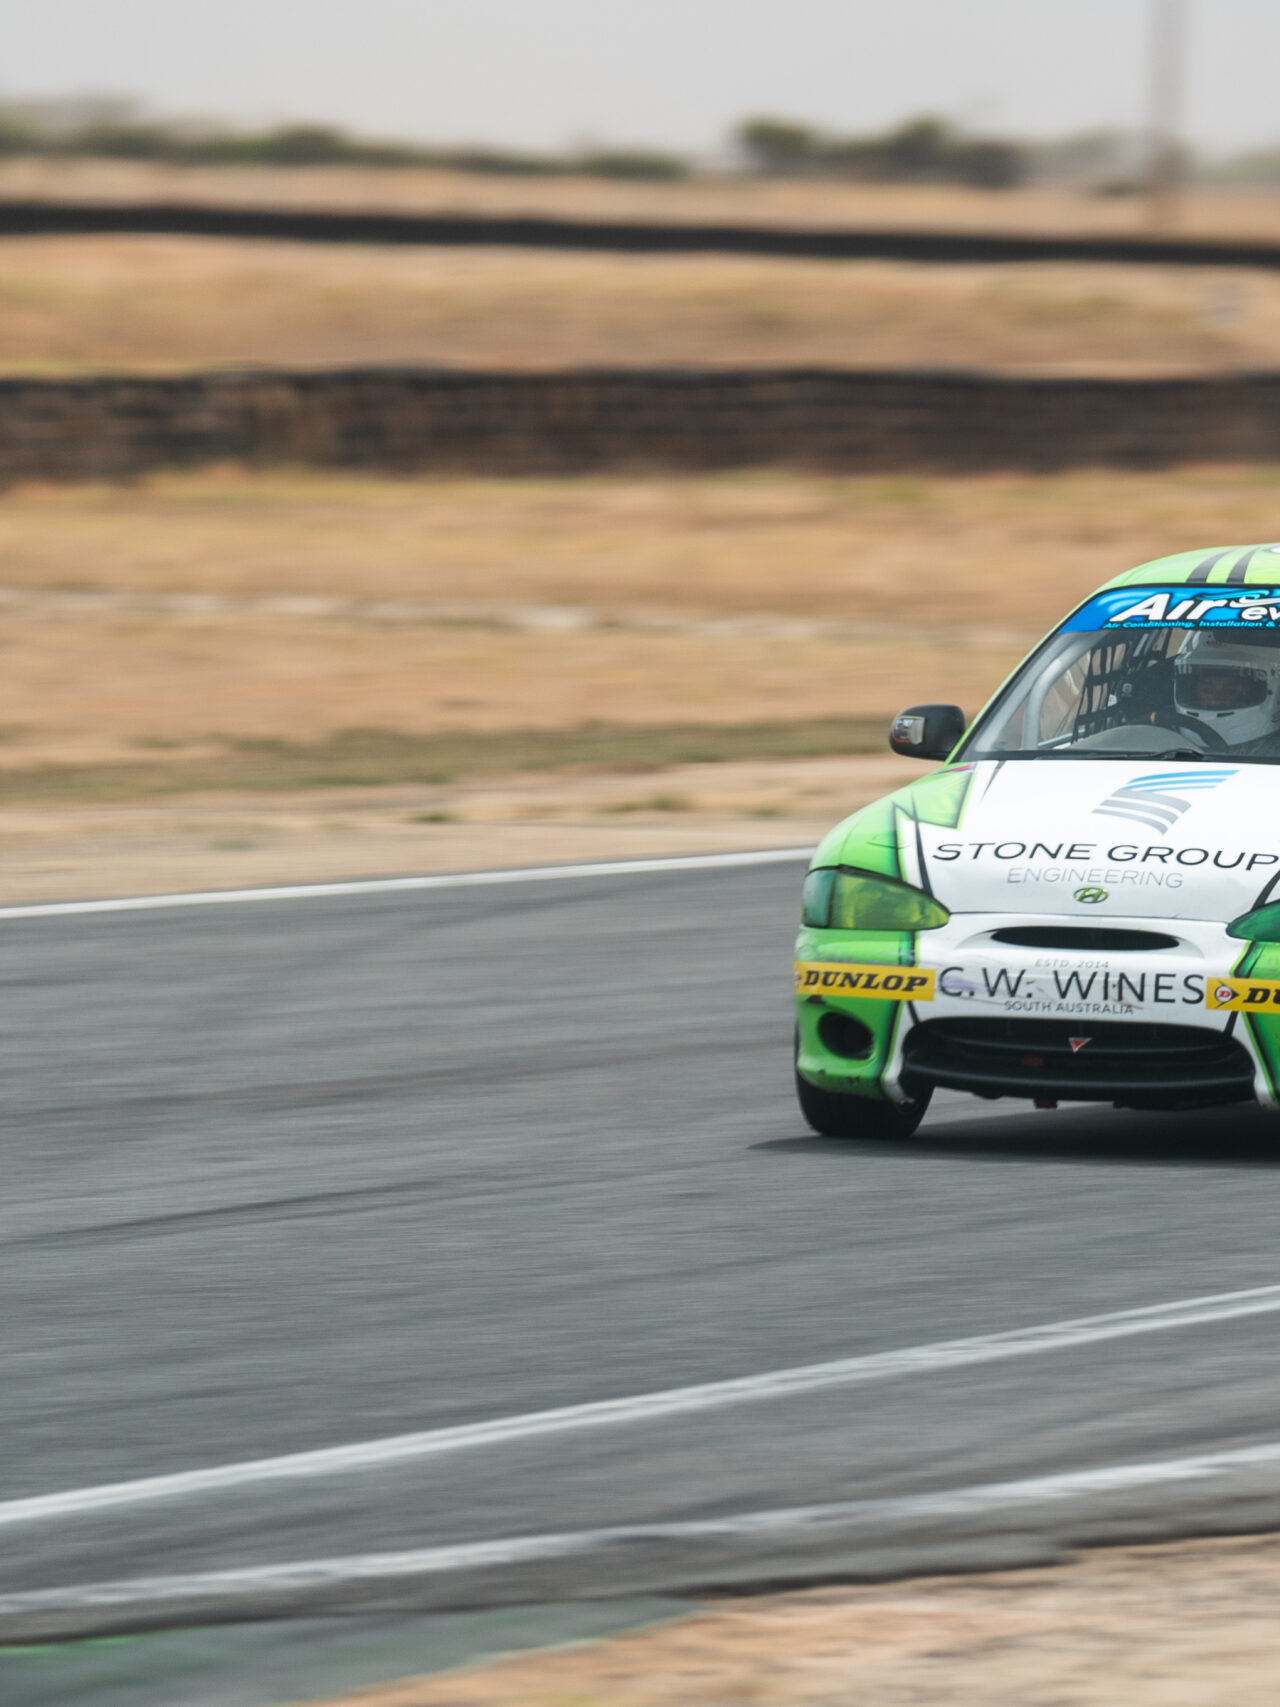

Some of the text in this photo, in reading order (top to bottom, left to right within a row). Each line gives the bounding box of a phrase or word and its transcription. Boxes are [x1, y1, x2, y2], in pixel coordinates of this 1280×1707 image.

[1109, 593, 1228, 622] Air
[1199, 621, 1263, 629] Installation
[932, 841, 1280, 871] STONE GROUP
[1006, 867, 1184, 889] ENGINEERING
[803, 970, 928, 993] DUNLOP
[1053, 969, 1205, 1005] WINES
[1004, 1000, 1134, 1015] SOUTH AUSTRALIA
